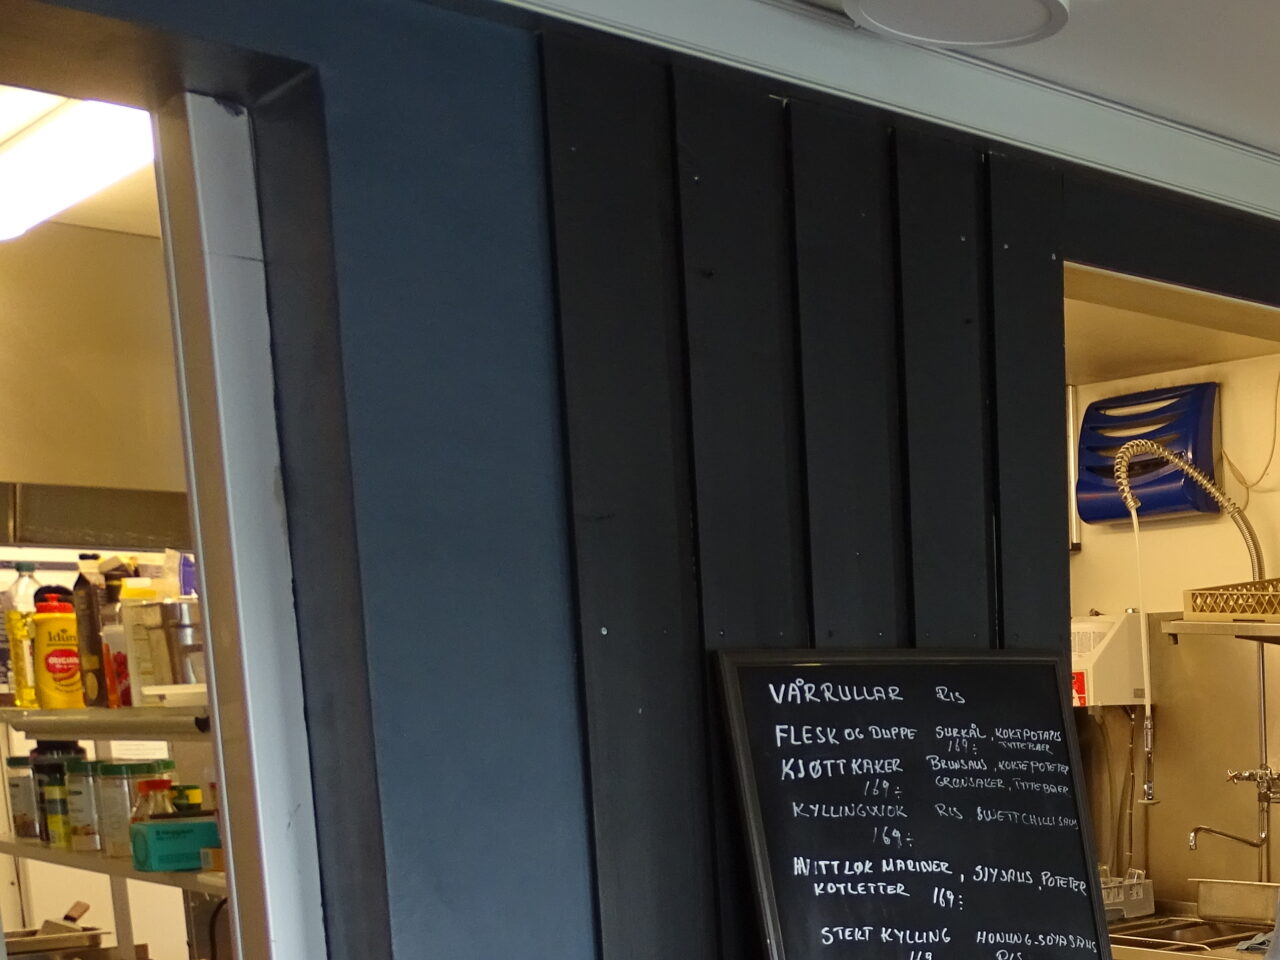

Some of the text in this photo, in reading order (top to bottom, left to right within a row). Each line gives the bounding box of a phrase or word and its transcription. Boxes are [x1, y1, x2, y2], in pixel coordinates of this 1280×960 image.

[768, 678, 904, 704] VÅRRULLAR
[935, 686, 966, 704] RIS
[775, 724, 918, 748] FLESK OG DUPPE
[935, 803, 963, 820] RIS
[814, 882, 911, 897] KOTLETTER
[821, 926, 873, 945] STEKT
[881, 927, 951, 944] KYLLING
